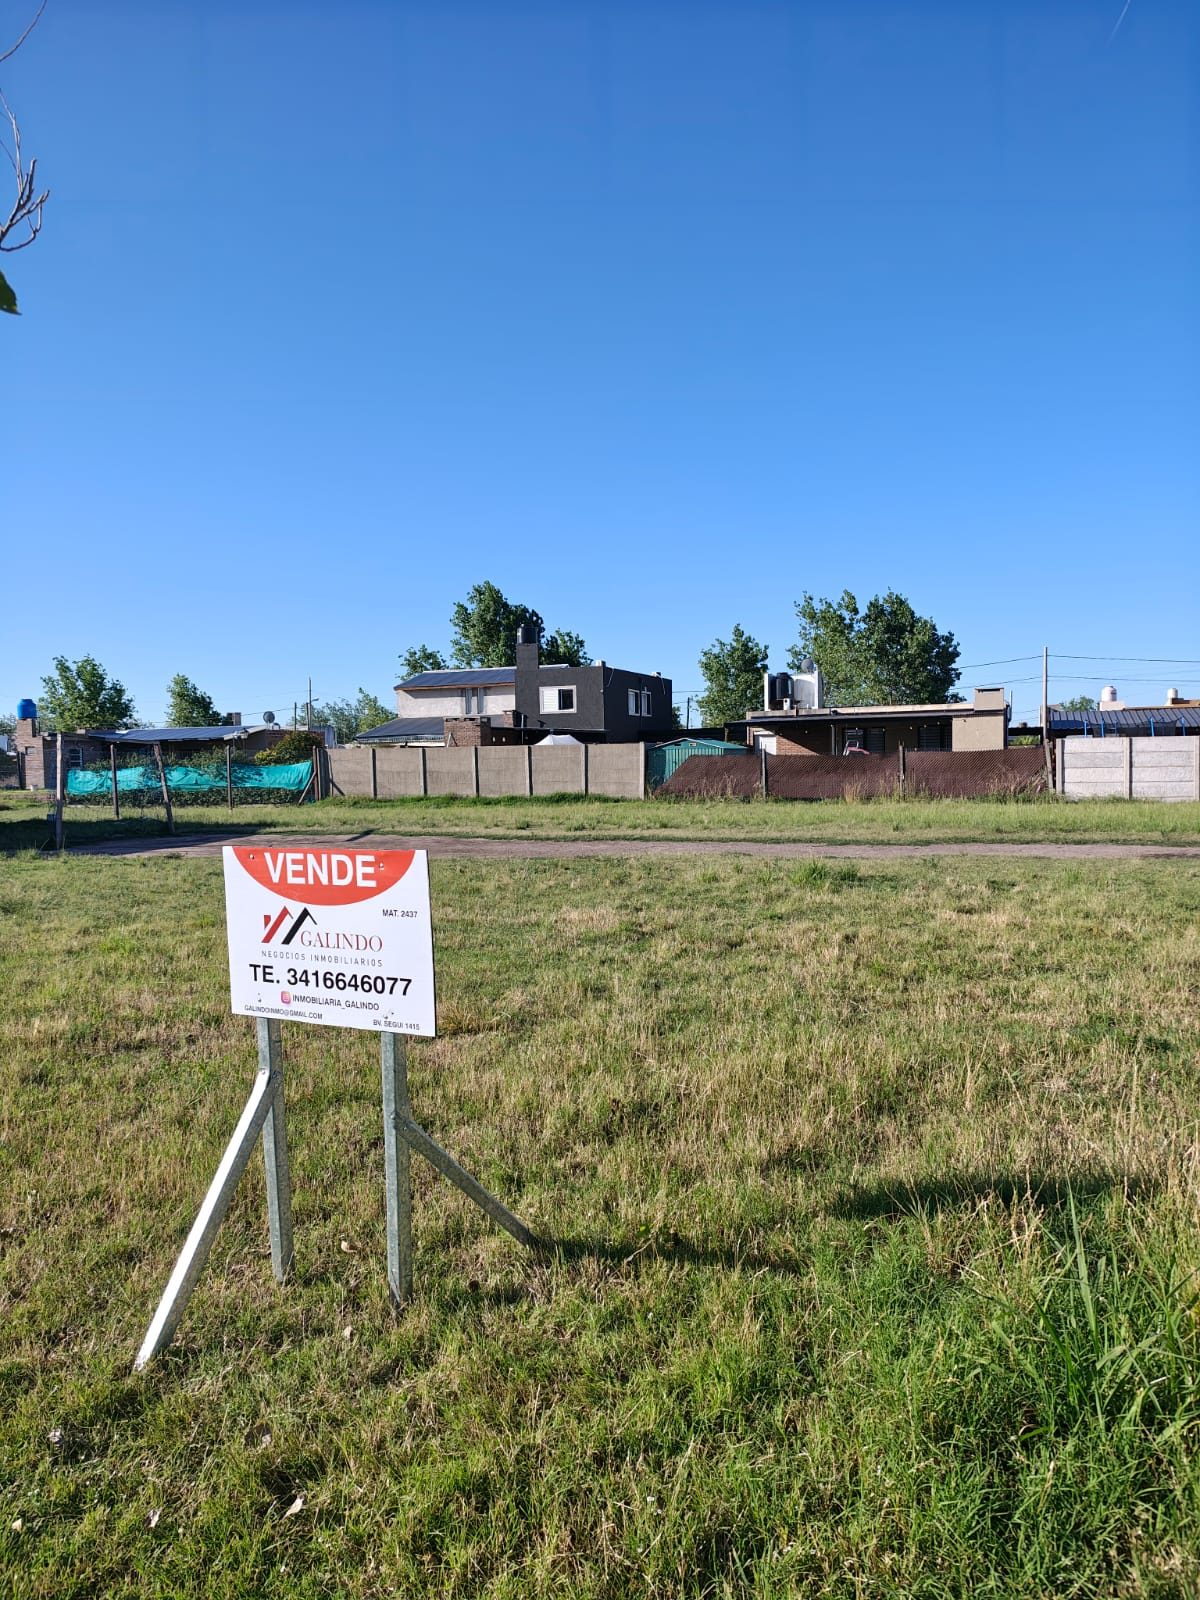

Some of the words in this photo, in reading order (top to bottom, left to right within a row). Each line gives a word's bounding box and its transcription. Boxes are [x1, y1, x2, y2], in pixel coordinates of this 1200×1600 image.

[264, 852, 377, 888] VENDE
[382, 909, 399, 918] MAT.
[401, 910, 418, 918] 2437
[300, 930, 383, 952] GALINDO
[261, 950, 306, 961] NEGOCIOS
[310, 954, 383, 967] INMOBILIARIOS
[249, 964, 280, 984] TE.
[287, 968, 413, 996] 3416646077
[384, 1020, 404, 1029] SEGUI
[405, 1022, 420, 1031] 1415
